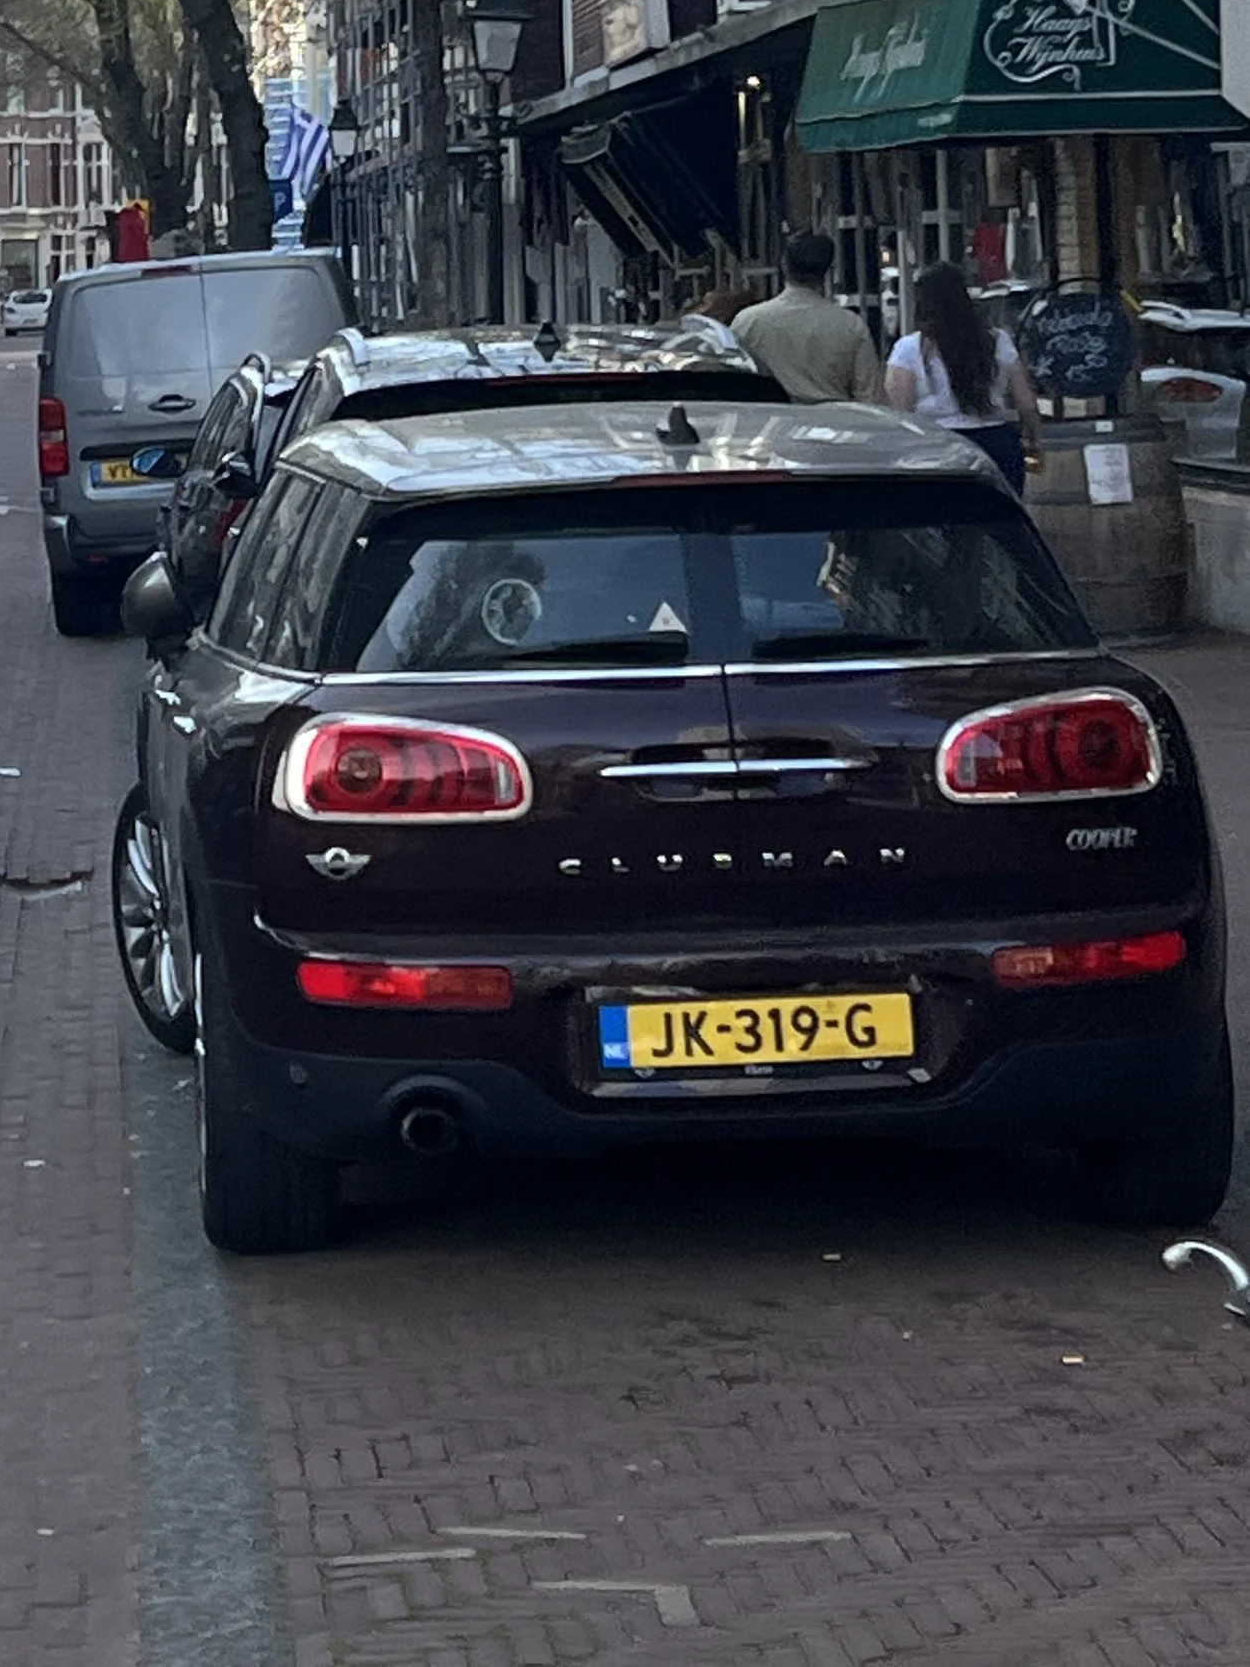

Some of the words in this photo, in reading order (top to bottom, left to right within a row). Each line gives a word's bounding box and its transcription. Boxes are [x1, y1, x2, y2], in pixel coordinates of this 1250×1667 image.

[1065, 827, 1138, 851] COOPER
[558, 848, 906, 876] CLUBMAN
[651, 1002, 877, 1059] JK-319-G
